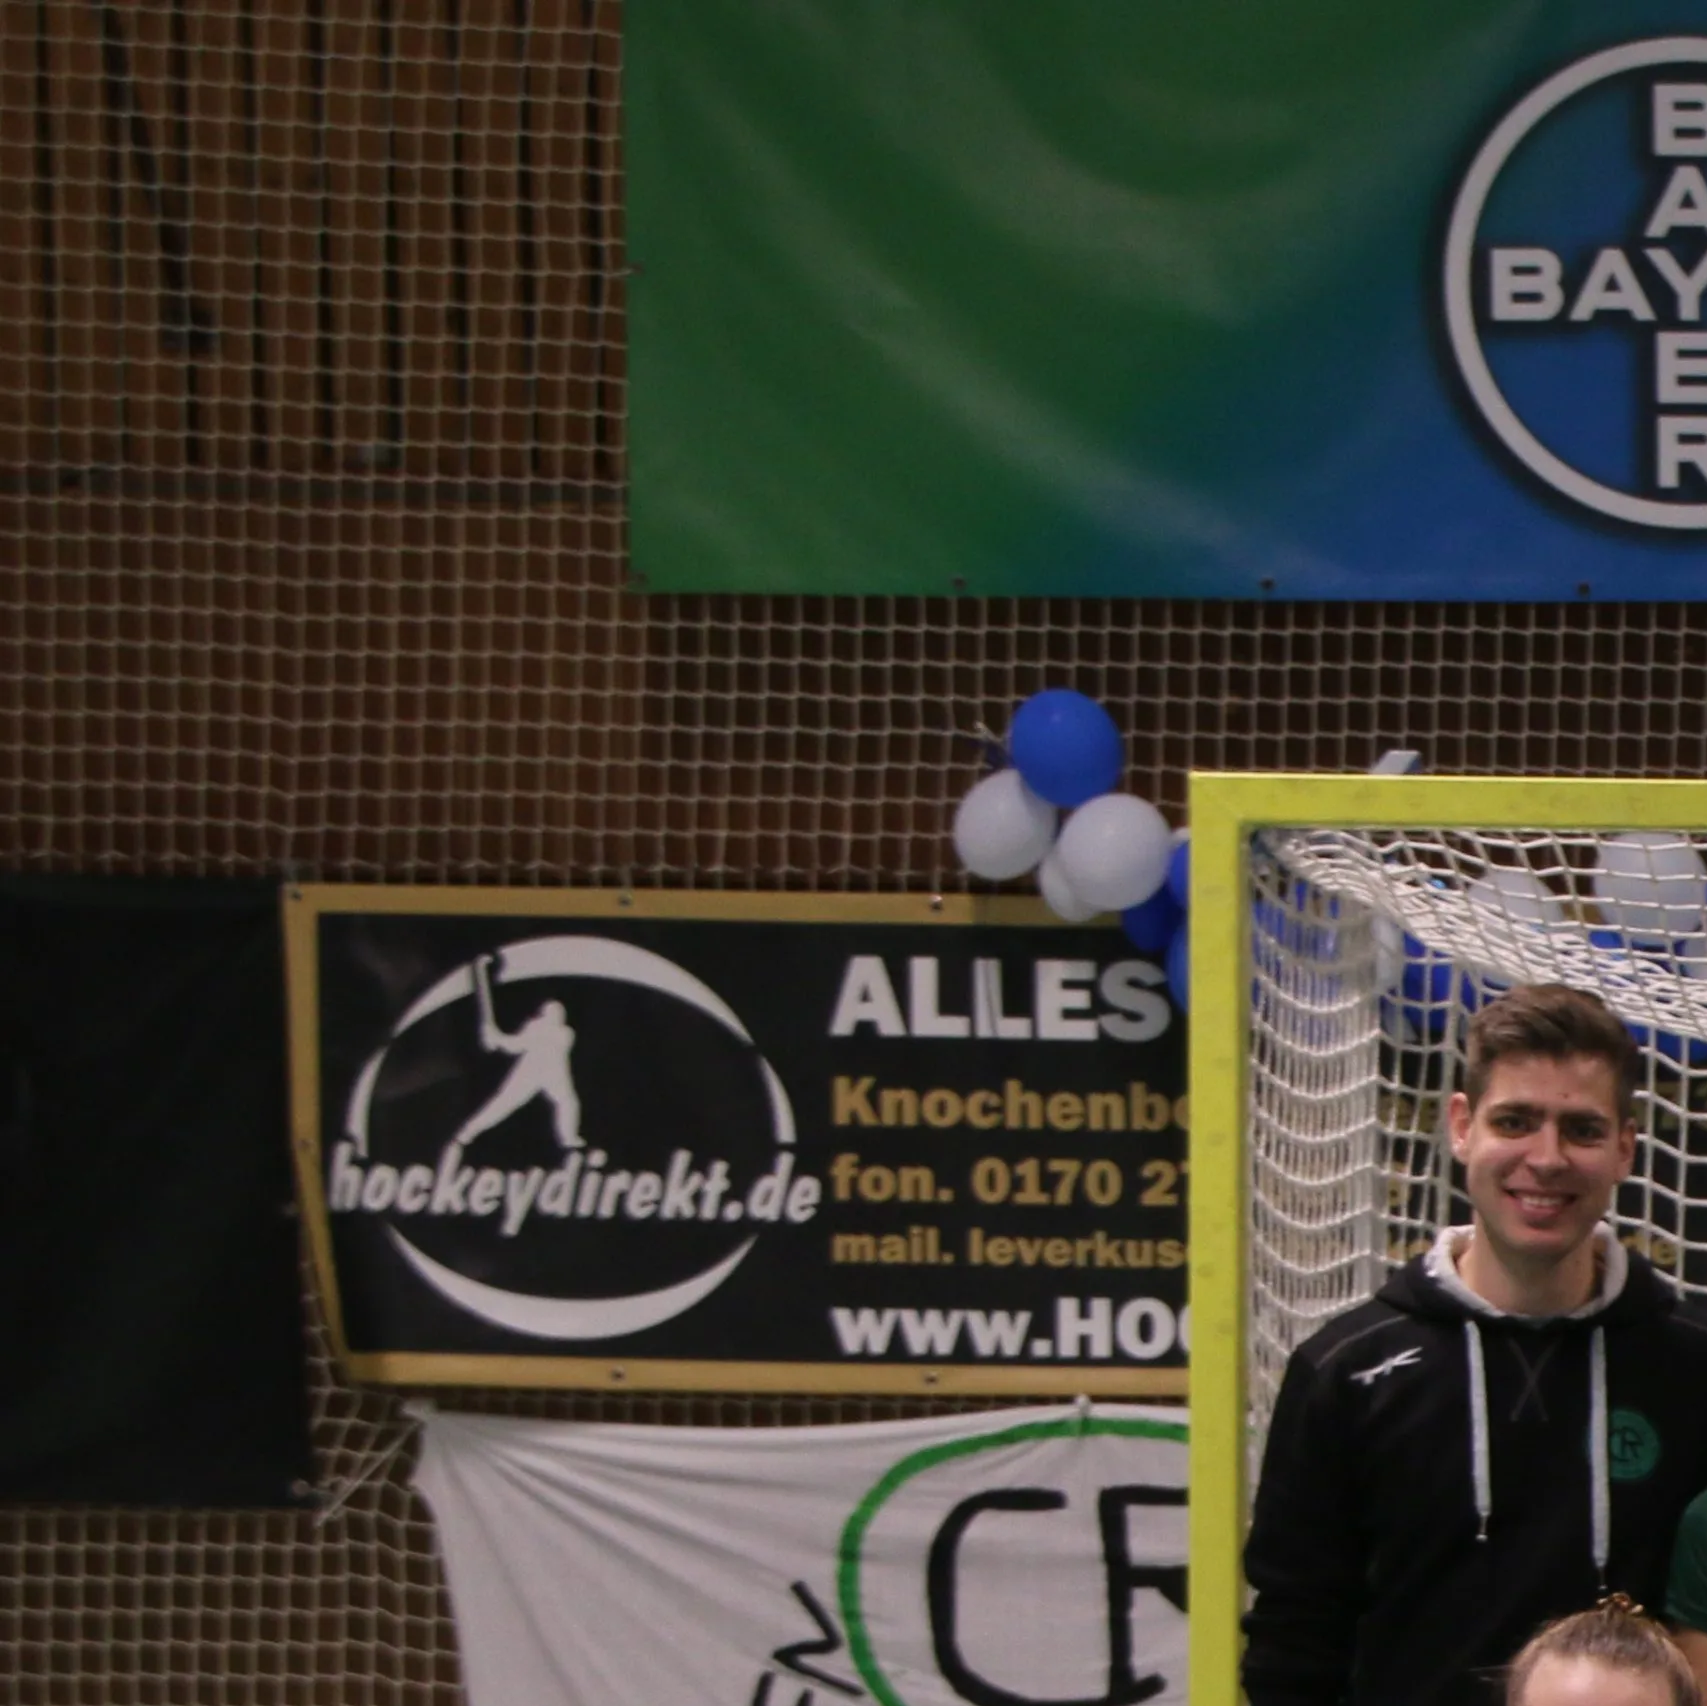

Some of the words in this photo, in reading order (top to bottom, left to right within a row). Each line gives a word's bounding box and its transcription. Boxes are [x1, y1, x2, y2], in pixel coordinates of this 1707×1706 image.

[829, 955, 1172, 1042] ALLES
[331, 1138, 821, 1237] hockeydirekt.de
[830, 1152, 955, 1203] fon.
[972, 1157, 1124, 1208] 0170
[830, 1225, 955, 1267] mail.
[968, 1226, 1188, 1271] leverkus
